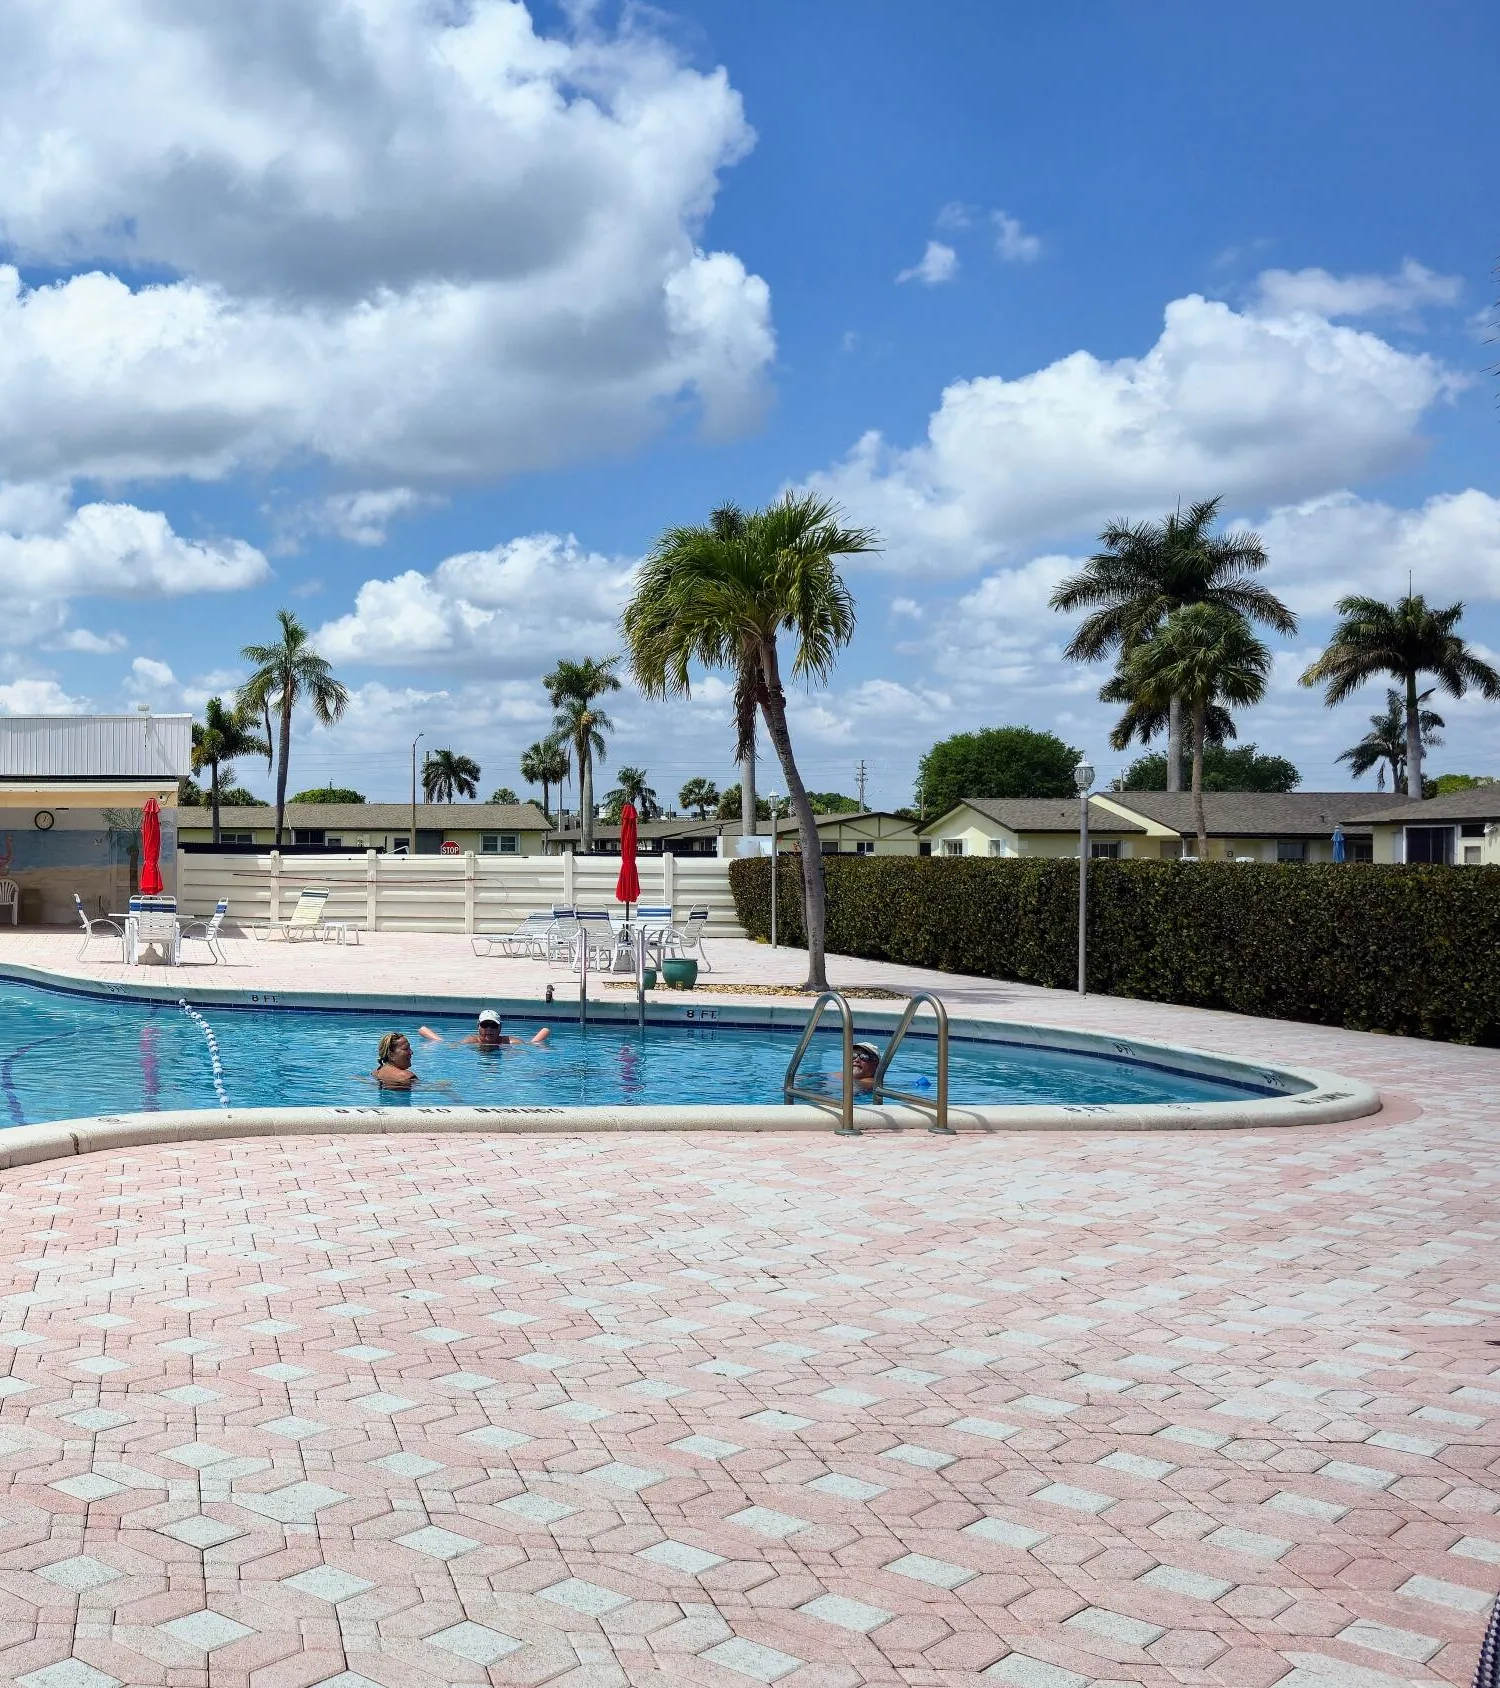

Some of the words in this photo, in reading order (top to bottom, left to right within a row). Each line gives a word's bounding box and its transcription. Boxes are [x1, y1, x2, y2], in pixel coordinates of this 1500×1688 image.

[442, 846, 459, 854] STOP
[251, 994, 260, 1002] 8
[686, 1009, 696, 1019] 8
[701, 1010, 717, 1019] FT.
